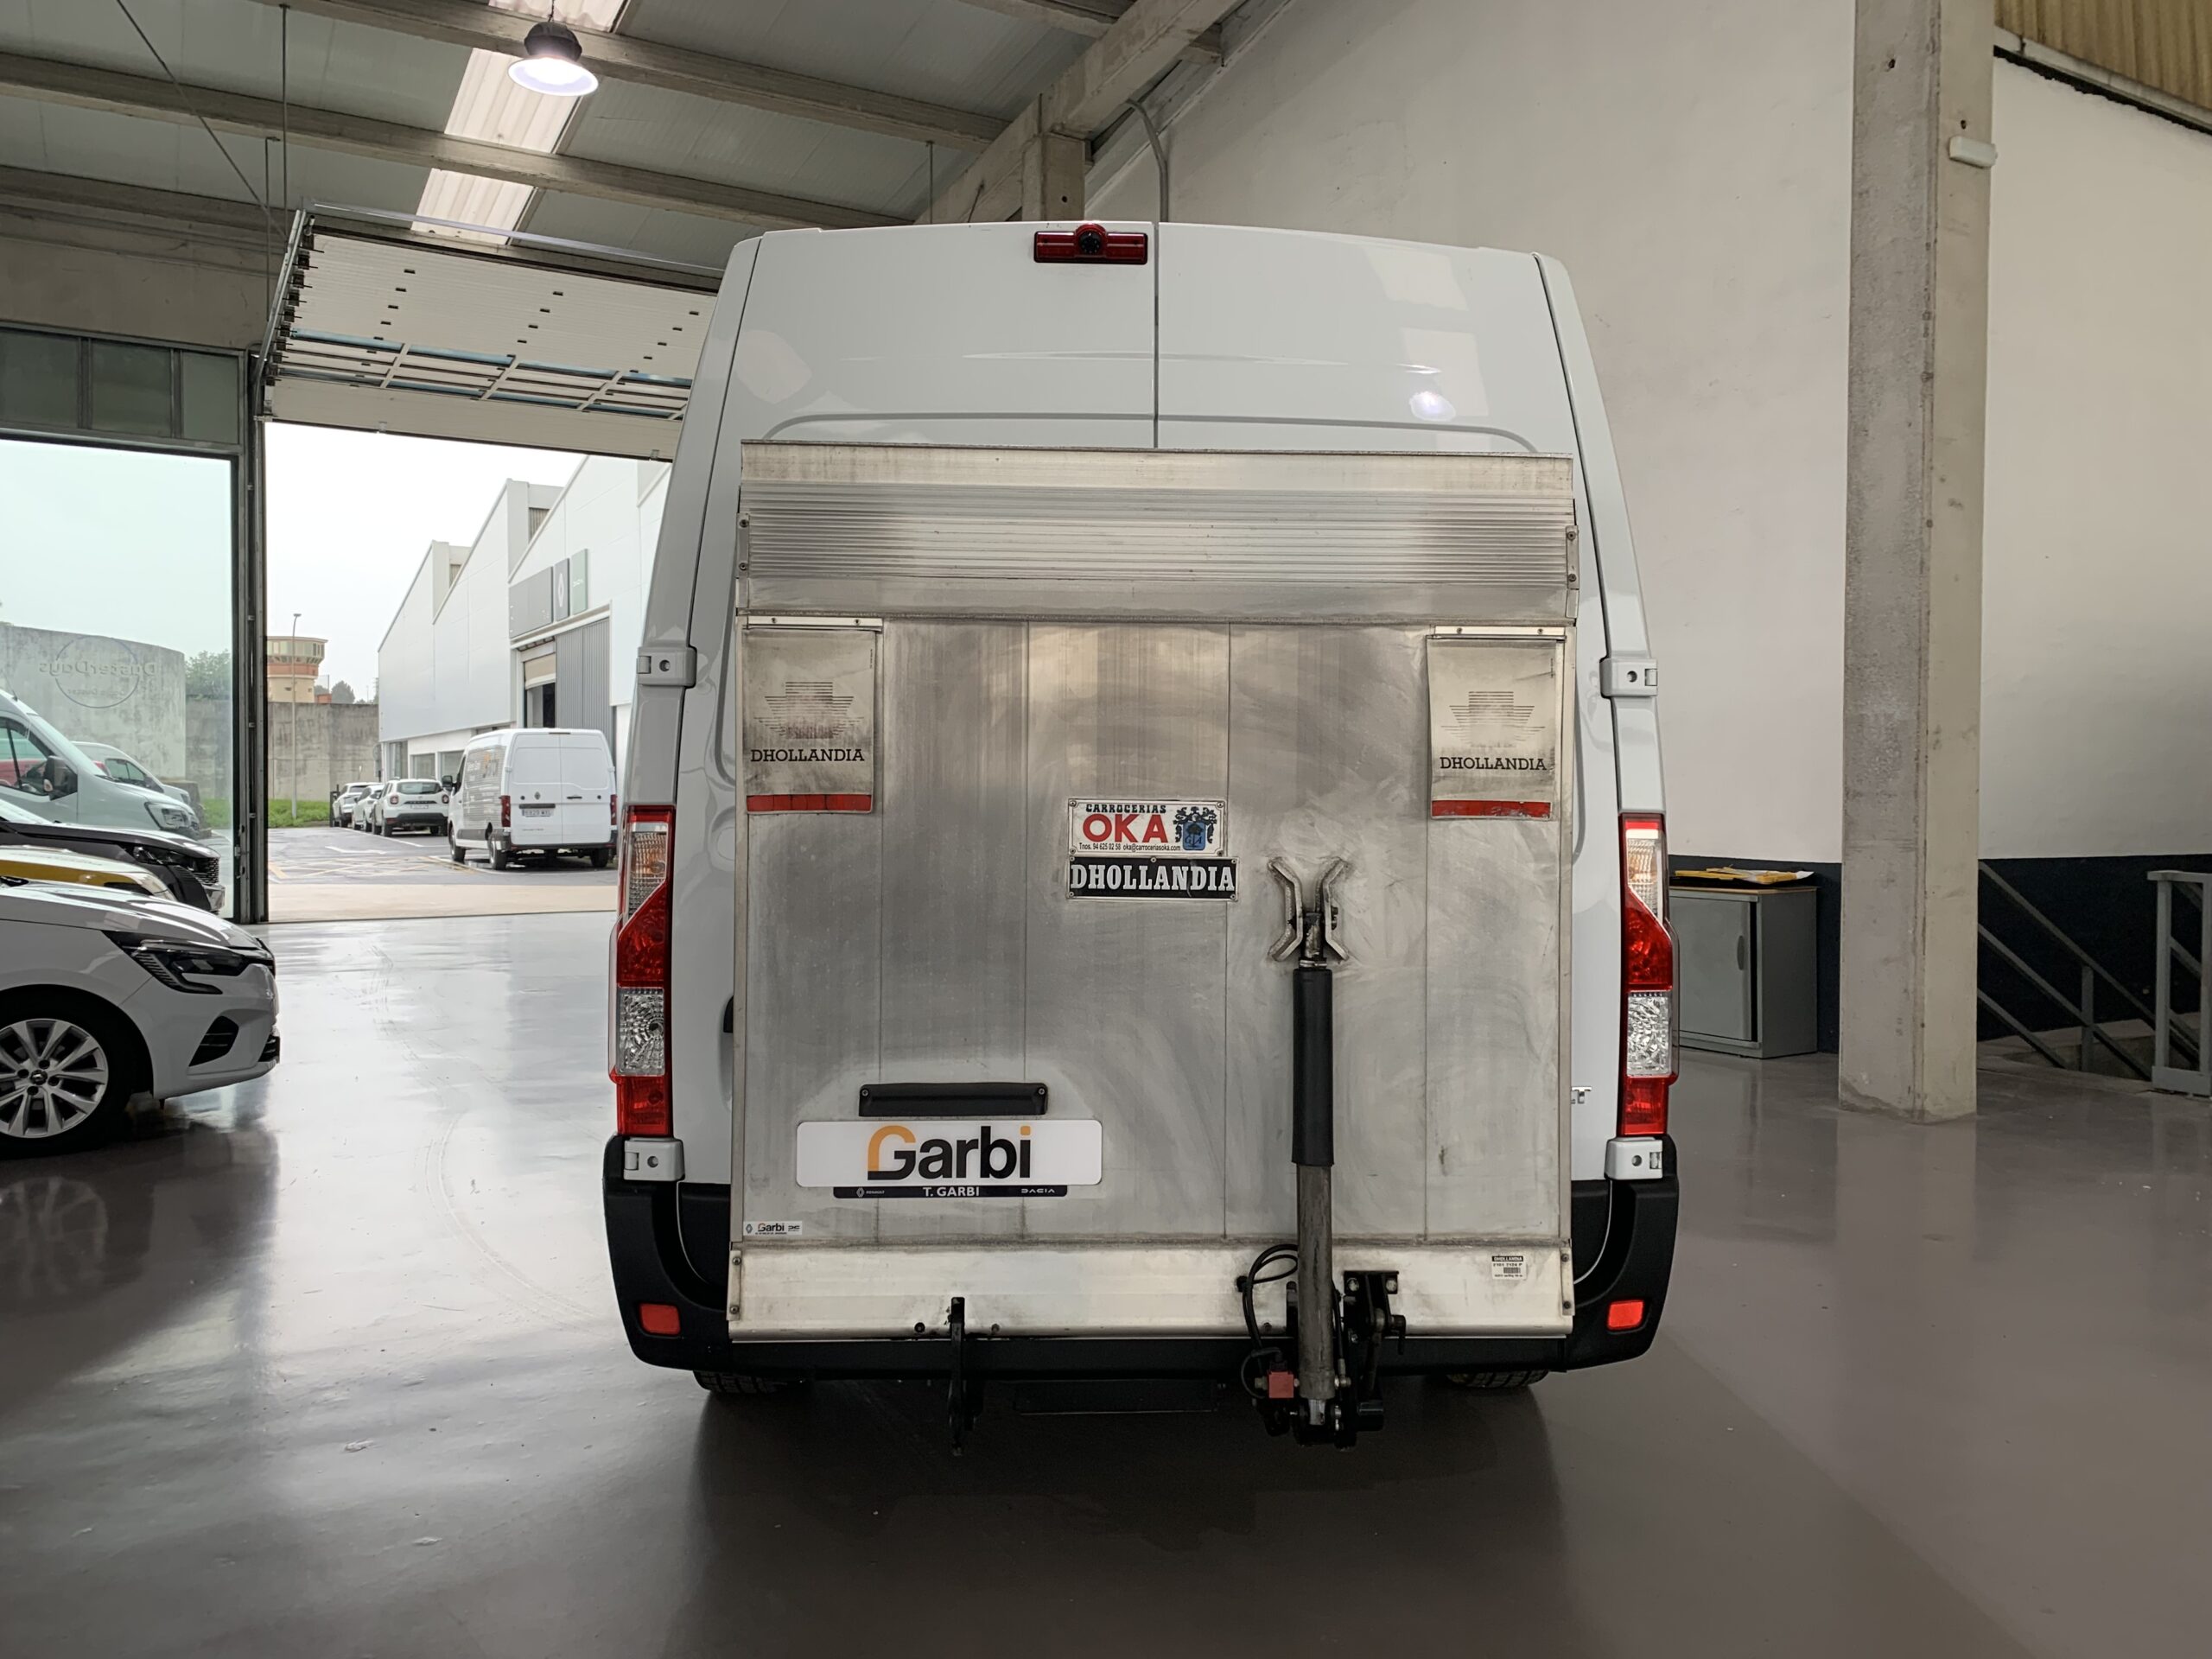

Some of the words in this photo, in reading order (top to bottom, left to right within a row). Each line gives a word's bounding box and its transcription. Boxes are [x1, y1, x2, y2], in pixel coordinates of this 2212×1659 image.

[750, 748, 865, 762] DHOLLANDIA
[1440, 756, 1548, 771] DHOLLANDIA
[1085, 804, 1166, 814] CARROCERIAS
[1082, 813, 1168, 842] OKA
[1122, 843, 1181, 853] oka@carroceriasoka.com
[1070, 864, 1235, 891] DHOLLANDIA
[867, 1124, 1032, 1181] Garbi
[923, 1187, 933, 1197] T.
[936, 1186, 980, 1197] GARBI
[758, 1223, 785, 1232] Garbi
